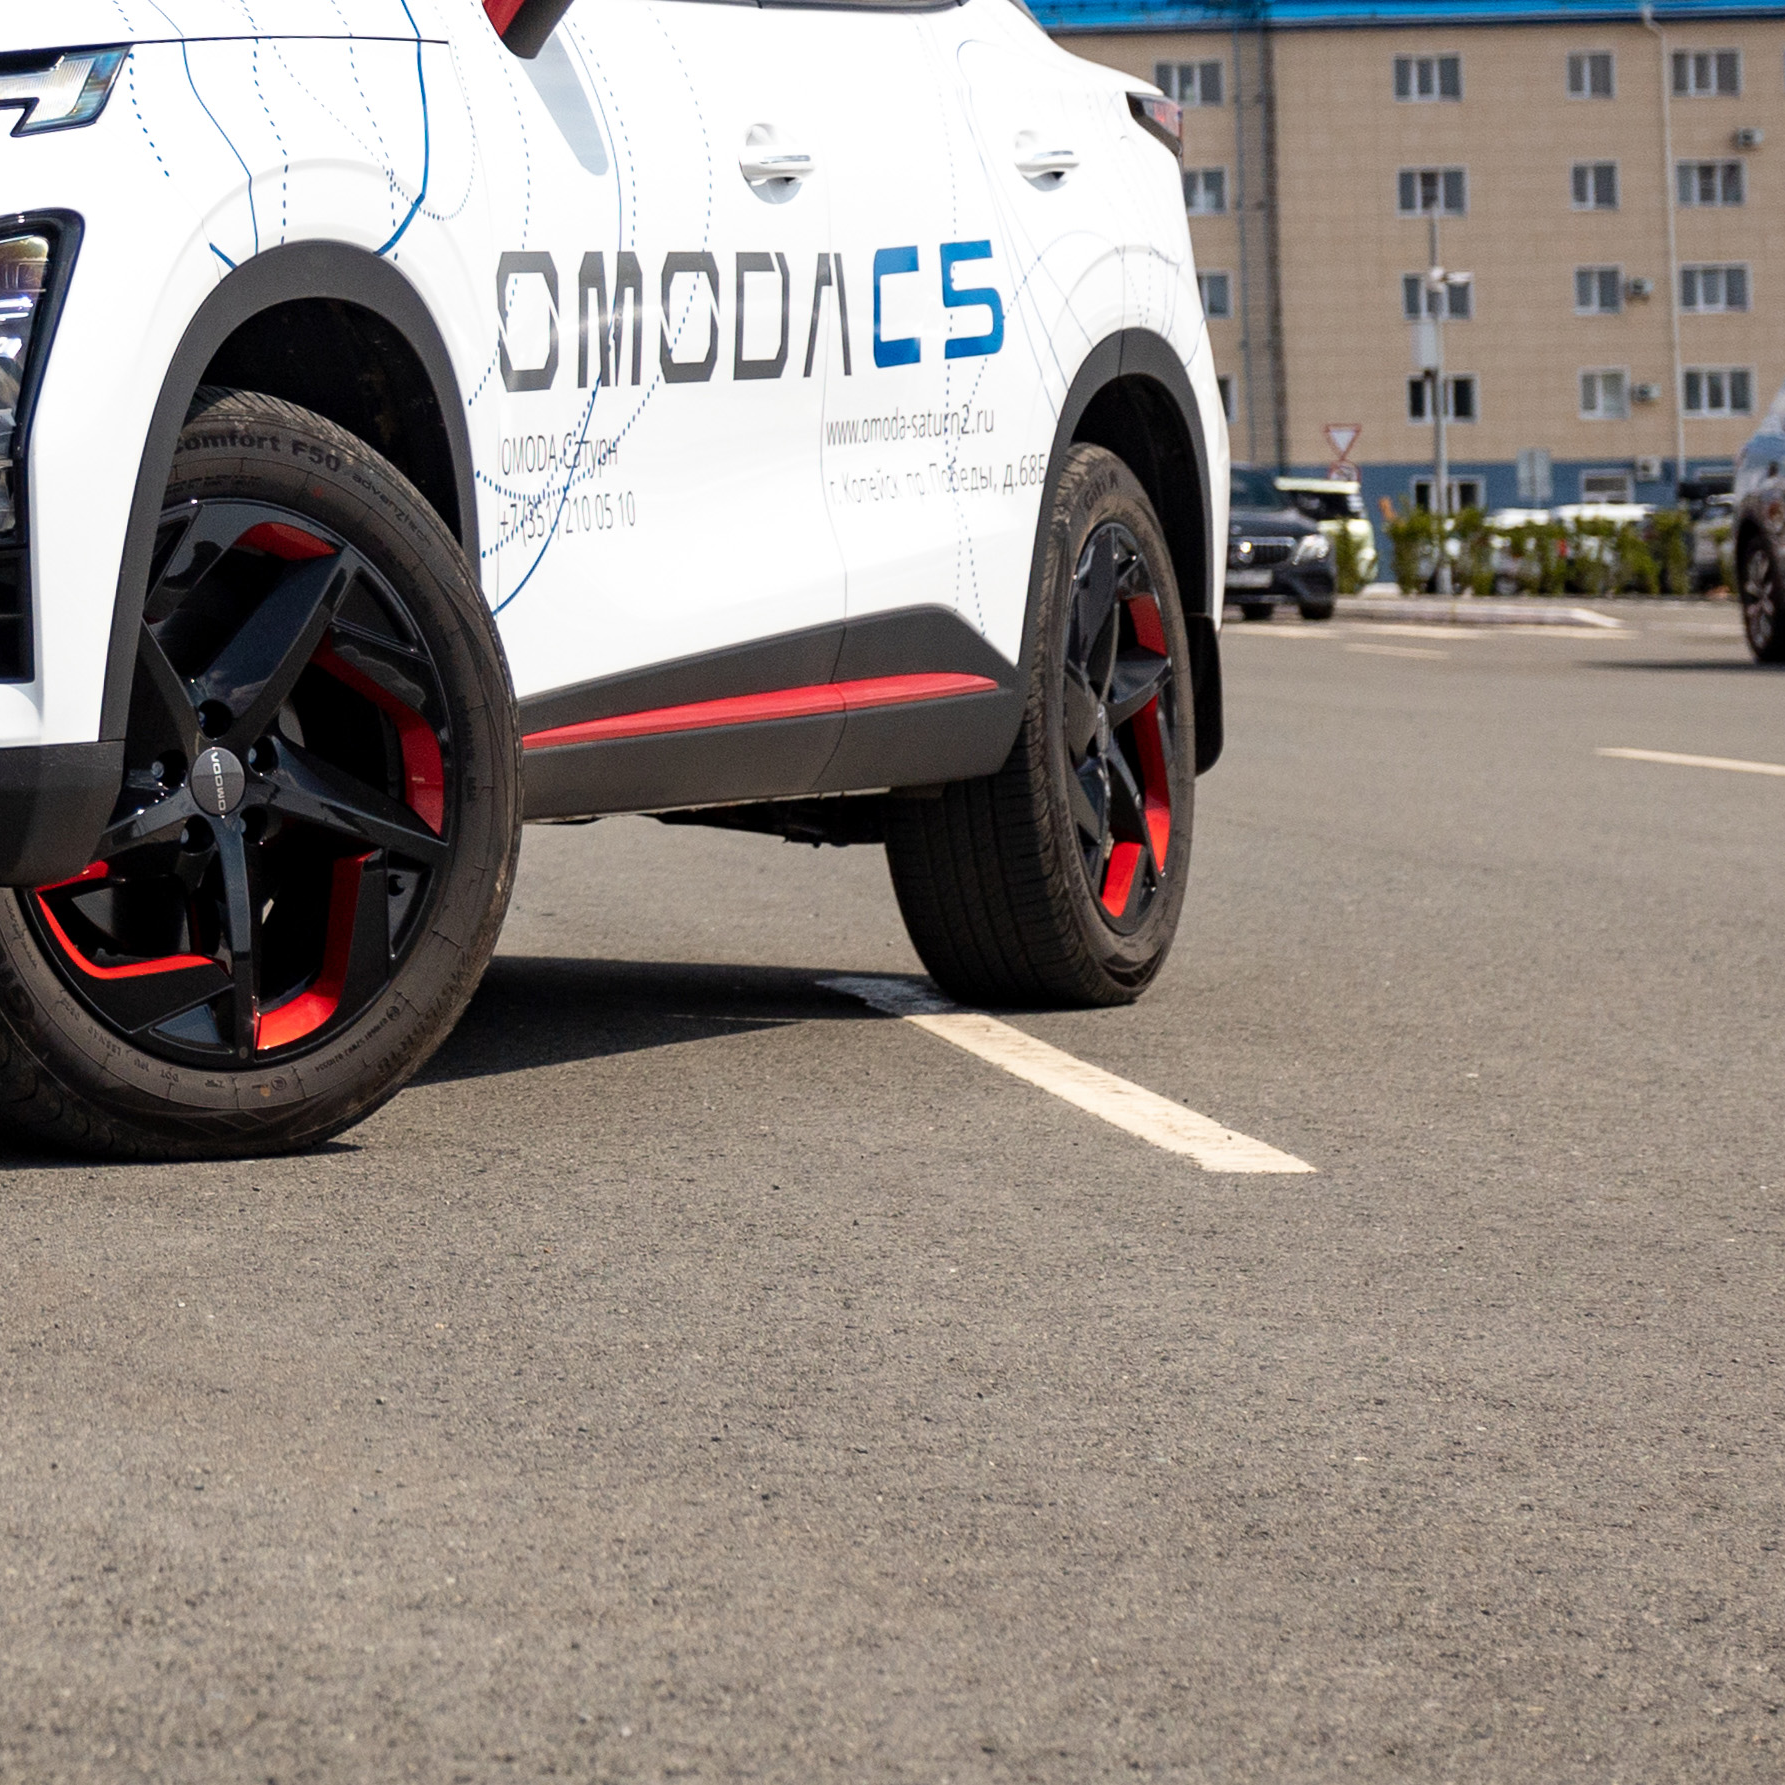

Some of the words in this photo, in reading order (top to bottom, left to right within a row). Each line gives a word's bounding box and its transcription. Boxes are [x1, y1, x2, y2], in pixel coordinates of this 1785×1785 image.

[496, 249, 854, 393] OMODA
[872, 240, 1005, 369] C5
[826, 403, 995, 447] www.omoda-saturn2.ru
[291, 439, 342, 473] F50
[501, 434, 559, 477] OMODA
[562, 432, 619, 479] Сатурн
[499, 503, 519, 540] +7
[564, 495, 591, 534] 210
[595, 493, 614, 530] 05
[618, 490, 637, 527] 10
[210, 751, 226, 811] OMODA
